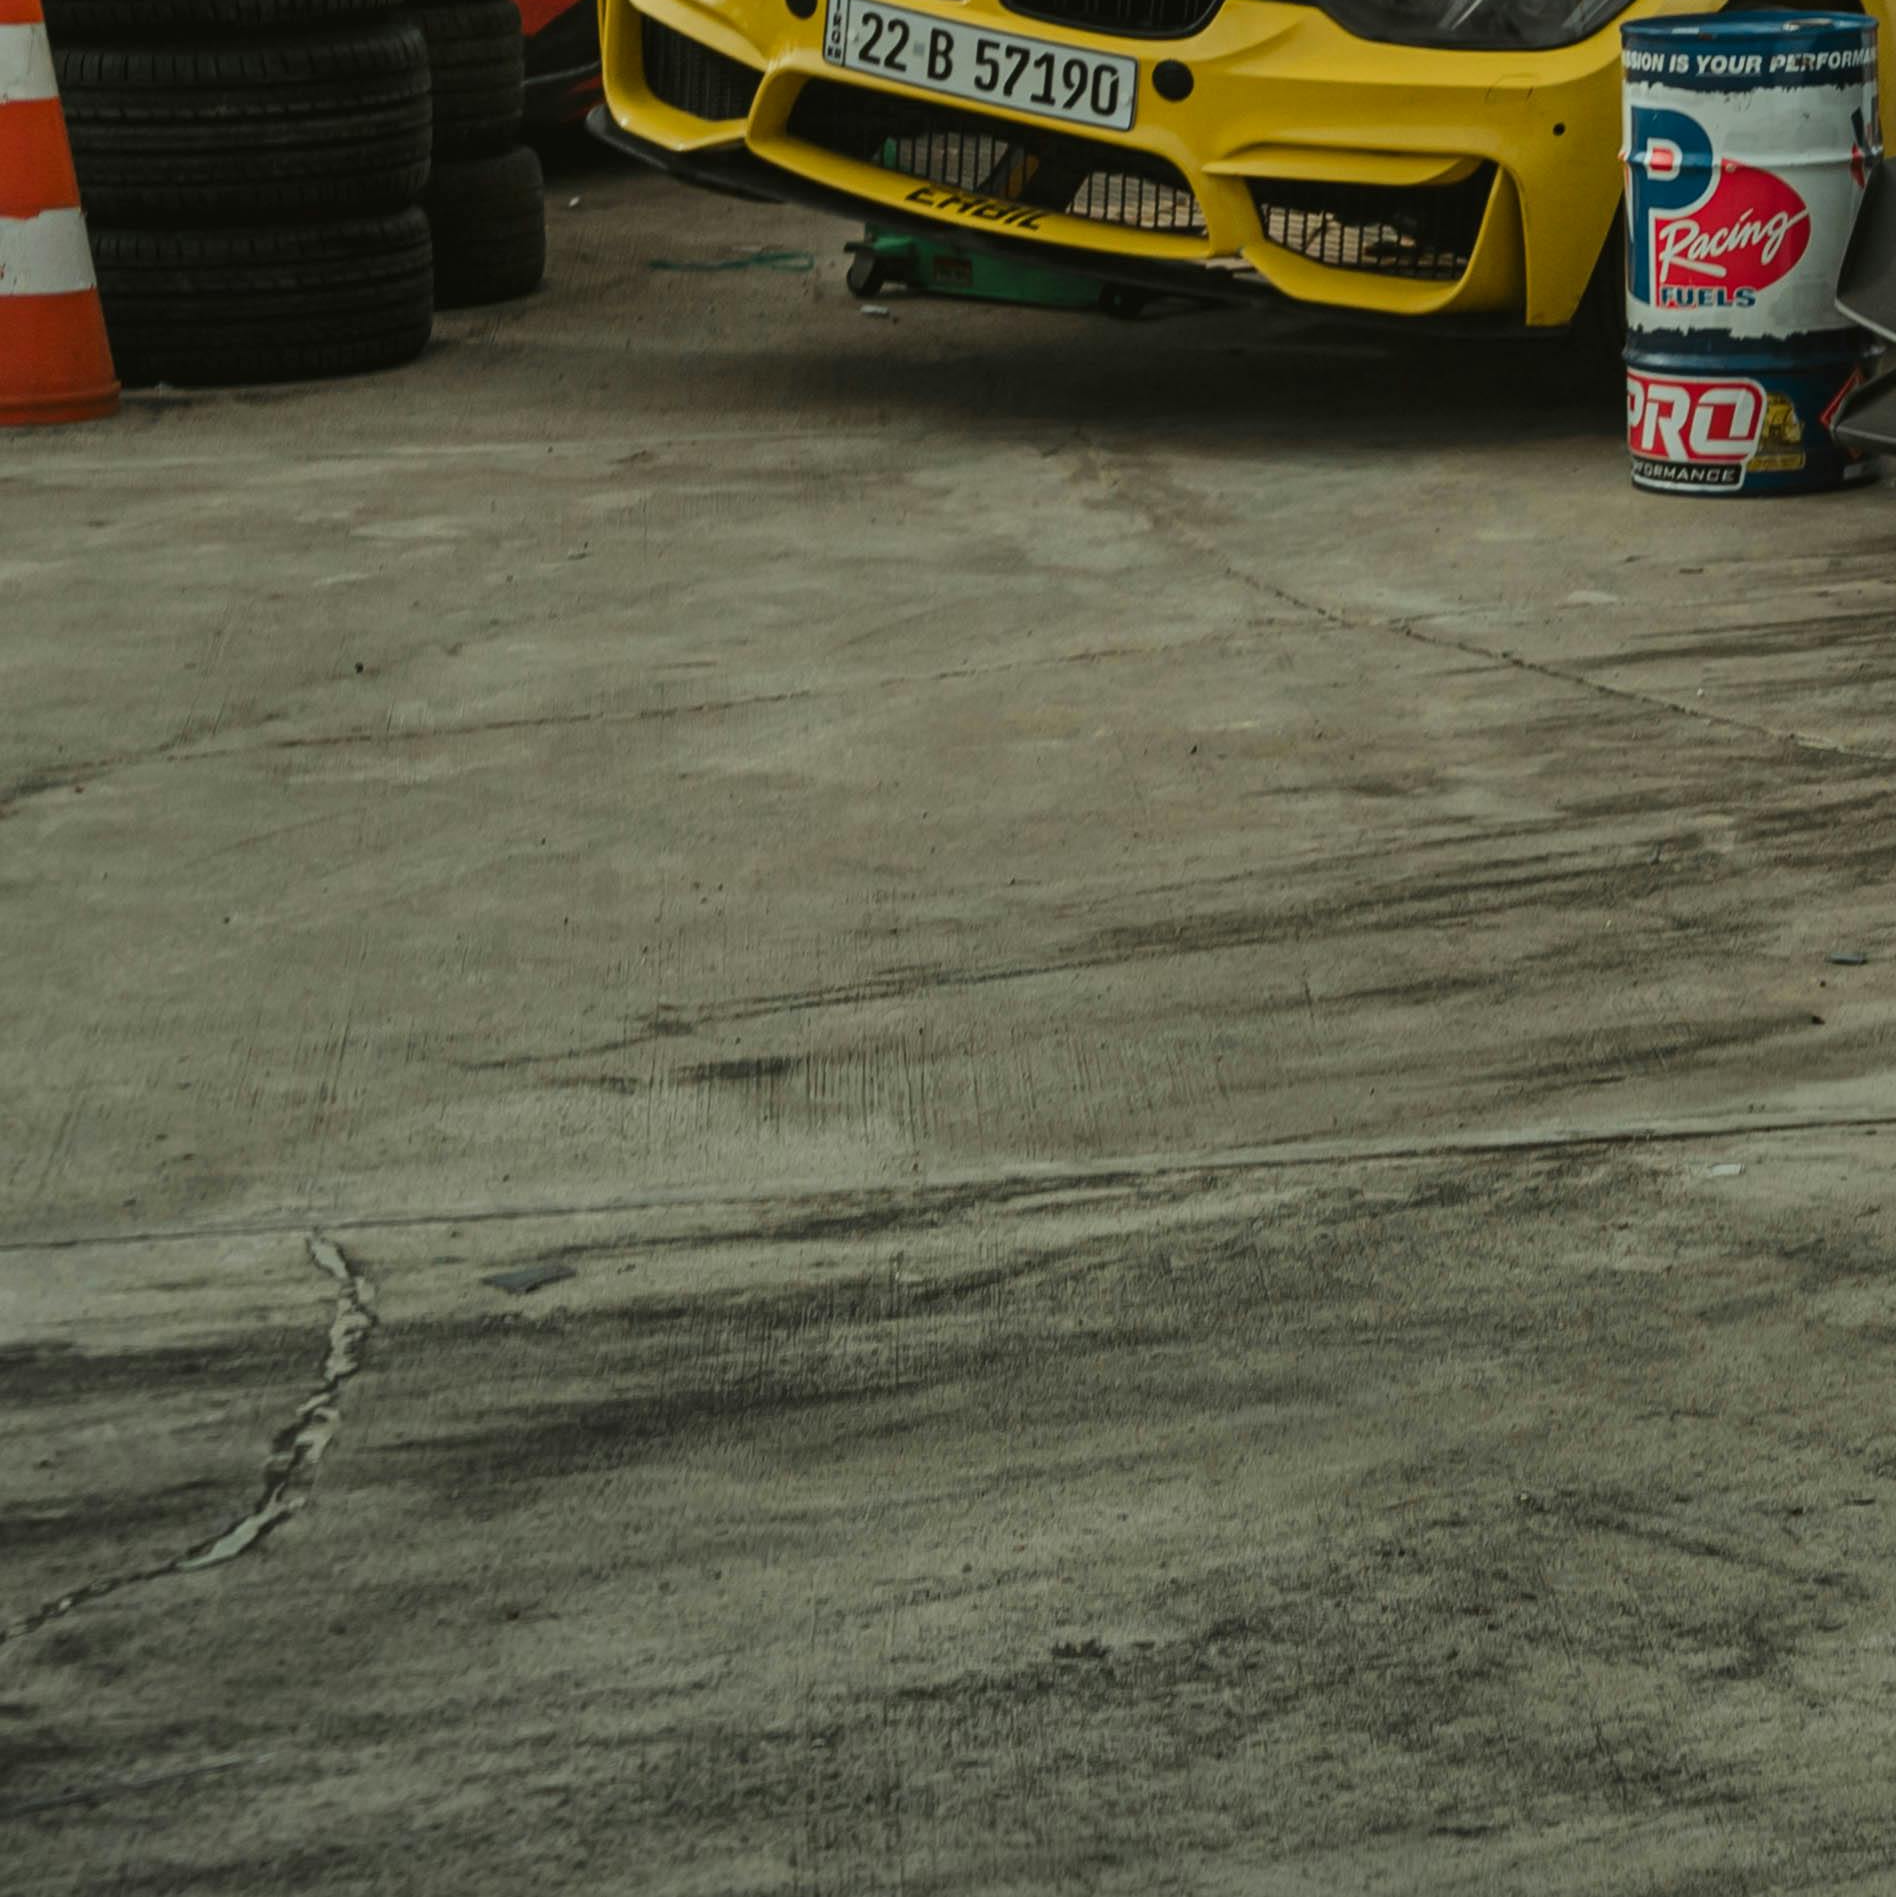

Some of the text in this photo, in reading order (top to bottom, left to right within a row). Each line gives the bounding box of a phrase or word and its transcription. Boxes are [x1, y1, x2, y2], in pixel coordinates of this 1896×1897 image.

[858, 12, 1119, 116] 22 B 57190
[1669, 55, 1689, 73] IS
[1696, 55, 1762, 75] YOUR
[1659, 208, 1809, 283] Racing
[1661, 286, 1757, 308] FUELS
